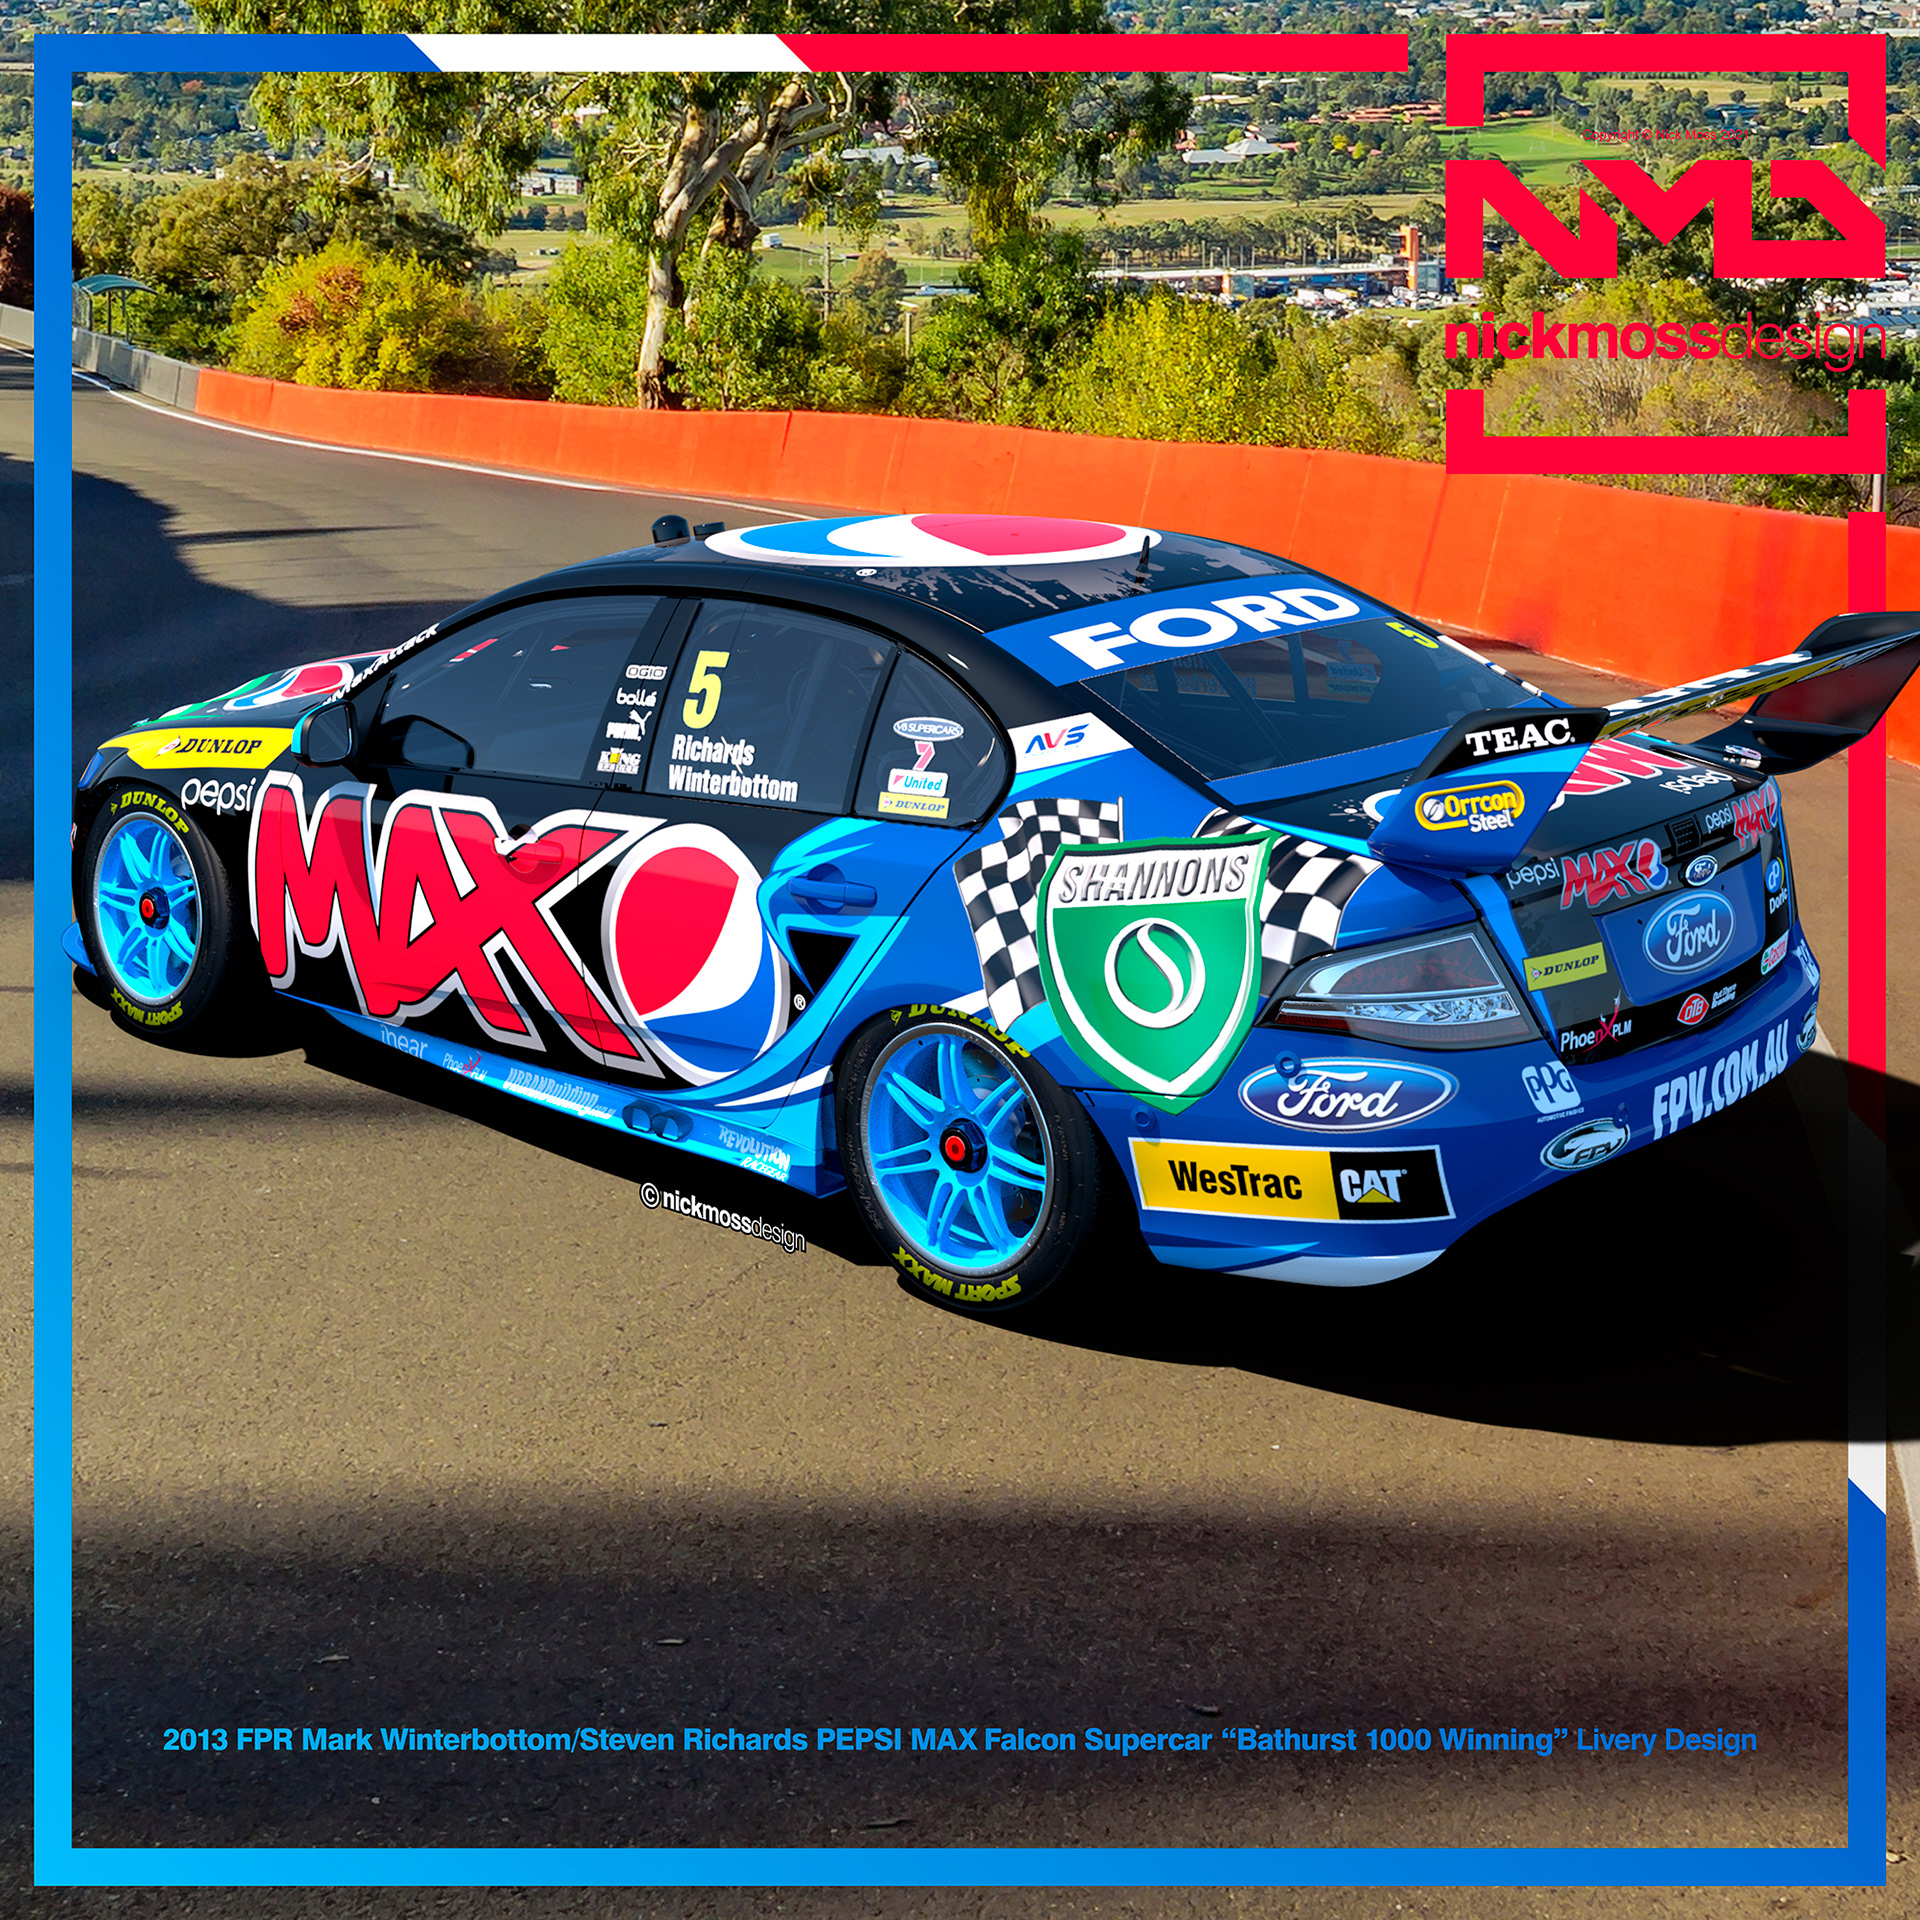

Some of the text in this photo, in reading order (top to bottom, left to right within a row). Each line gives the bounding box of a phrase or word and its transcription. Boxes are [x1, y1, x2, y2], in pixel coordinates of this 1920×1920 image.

[1050, 588, 1361, 670] FORD
[1385, 622, 1439, 648] 5
[323, 622, 440, 706] MaxAttack
[626, 665, 667, 680] OGIO
[682, 650, 730, 729] 5
[177, 738, 262, 754] DUNLOP
[671, 734, 755, 766] Richards
[1465, 718, 1571, 756] TEAC
[181, 777, 257, 816] pepsi
[669, 764, 798, 803] Winterbottom
[904, 775, 943, 791] United
[1659, 769, 1734, 795] pepsi
[120, 791, 189, 834] DUNLOP
[895, 800, 945, 812] DUNLOP
[1445, 792, 1517, 818] Orrcon
[1469, 809, 1514, 833] Steel
[1706, 803, 1734, 834] pepsi
[1058, 852, 1249, 903] SHANNONS
[1506, 840, 1651, 910] pepsi MAX
[1769, 888, 1788, 914] Doric
[249, 770, 668, 1078] MAX
[1666, 903, 1721, 963] Ford
[1543, 955, 1599, 976] DUNLOP
[145, 1001, 183, 1026] SPORT
[1685, 998, 1704, 1020] OTB
[1277, 1069, 1404, 1118] Ford
[1525, 1063, 1575, 1104] PPG
[1652, 1018, 1789, 1141] FPV.COM.AU
[718, 1124, 791, 1172] REVOLUTION
[740, 1157, 787, 1182] RACEGEAR
[1168, 1160, 1303, 1200] WesTrac
[1339, 1169, 1402, 1203] CAT
[891, 1246, 1022, 1302] SPORT MAXX
